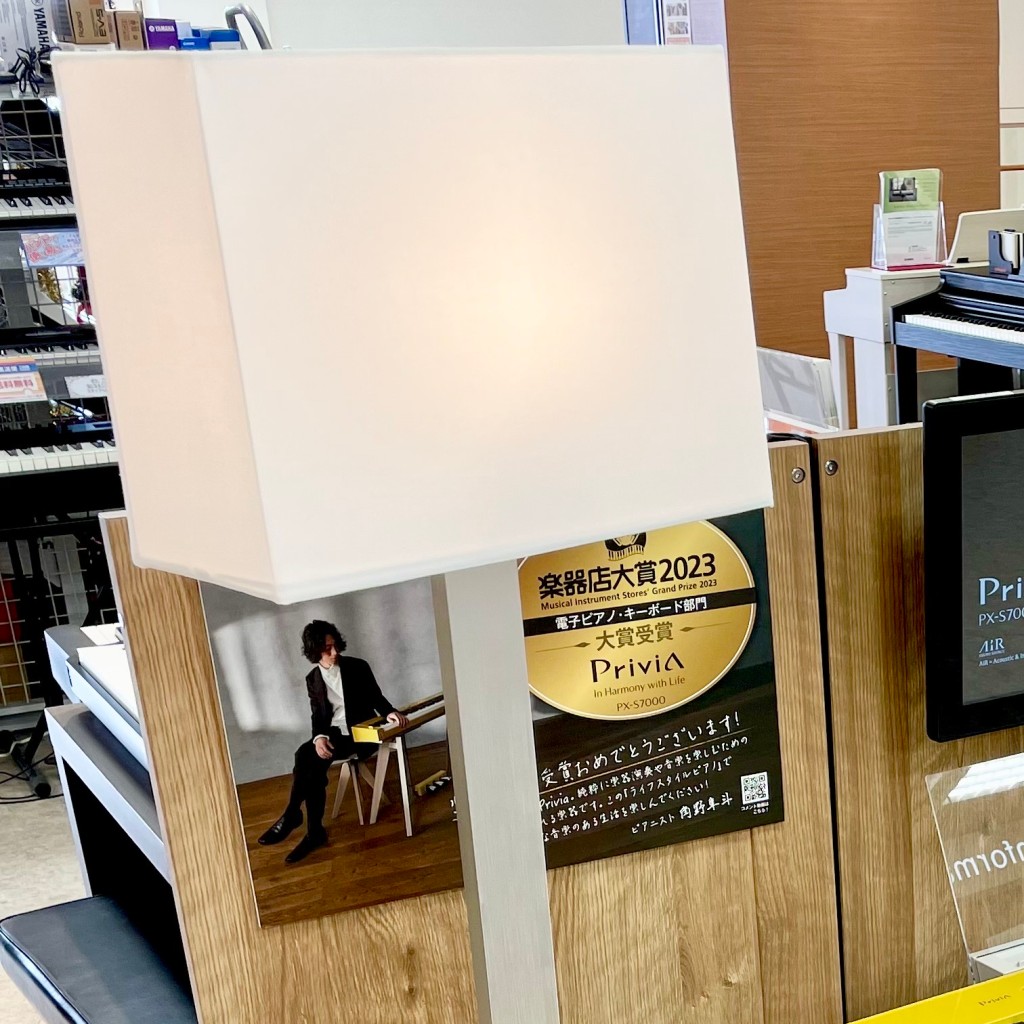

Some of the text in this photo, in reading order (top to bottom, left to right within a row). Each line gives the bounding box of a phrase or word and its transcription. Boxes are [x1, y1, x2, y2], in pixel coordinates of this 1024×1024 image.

[33, 7, 51, 52] YAMAHA
[75, 11, 85, 38] Roland
[537, 552, 716, 600] 楽器店大賞2023
[541, 578, 718, 611] Musical Instrument Stores' Grand Prize 2023
[555, 596, 707, 630] 電子ピアノ・キーボード部門
[595, 621, 674, 651] 大賞受賞
[593, 675, 686, 698] In Harmony with Life
[616, 695, 666, 712] PX-S7000
[631, 812, 676, 835] ピアニスト
